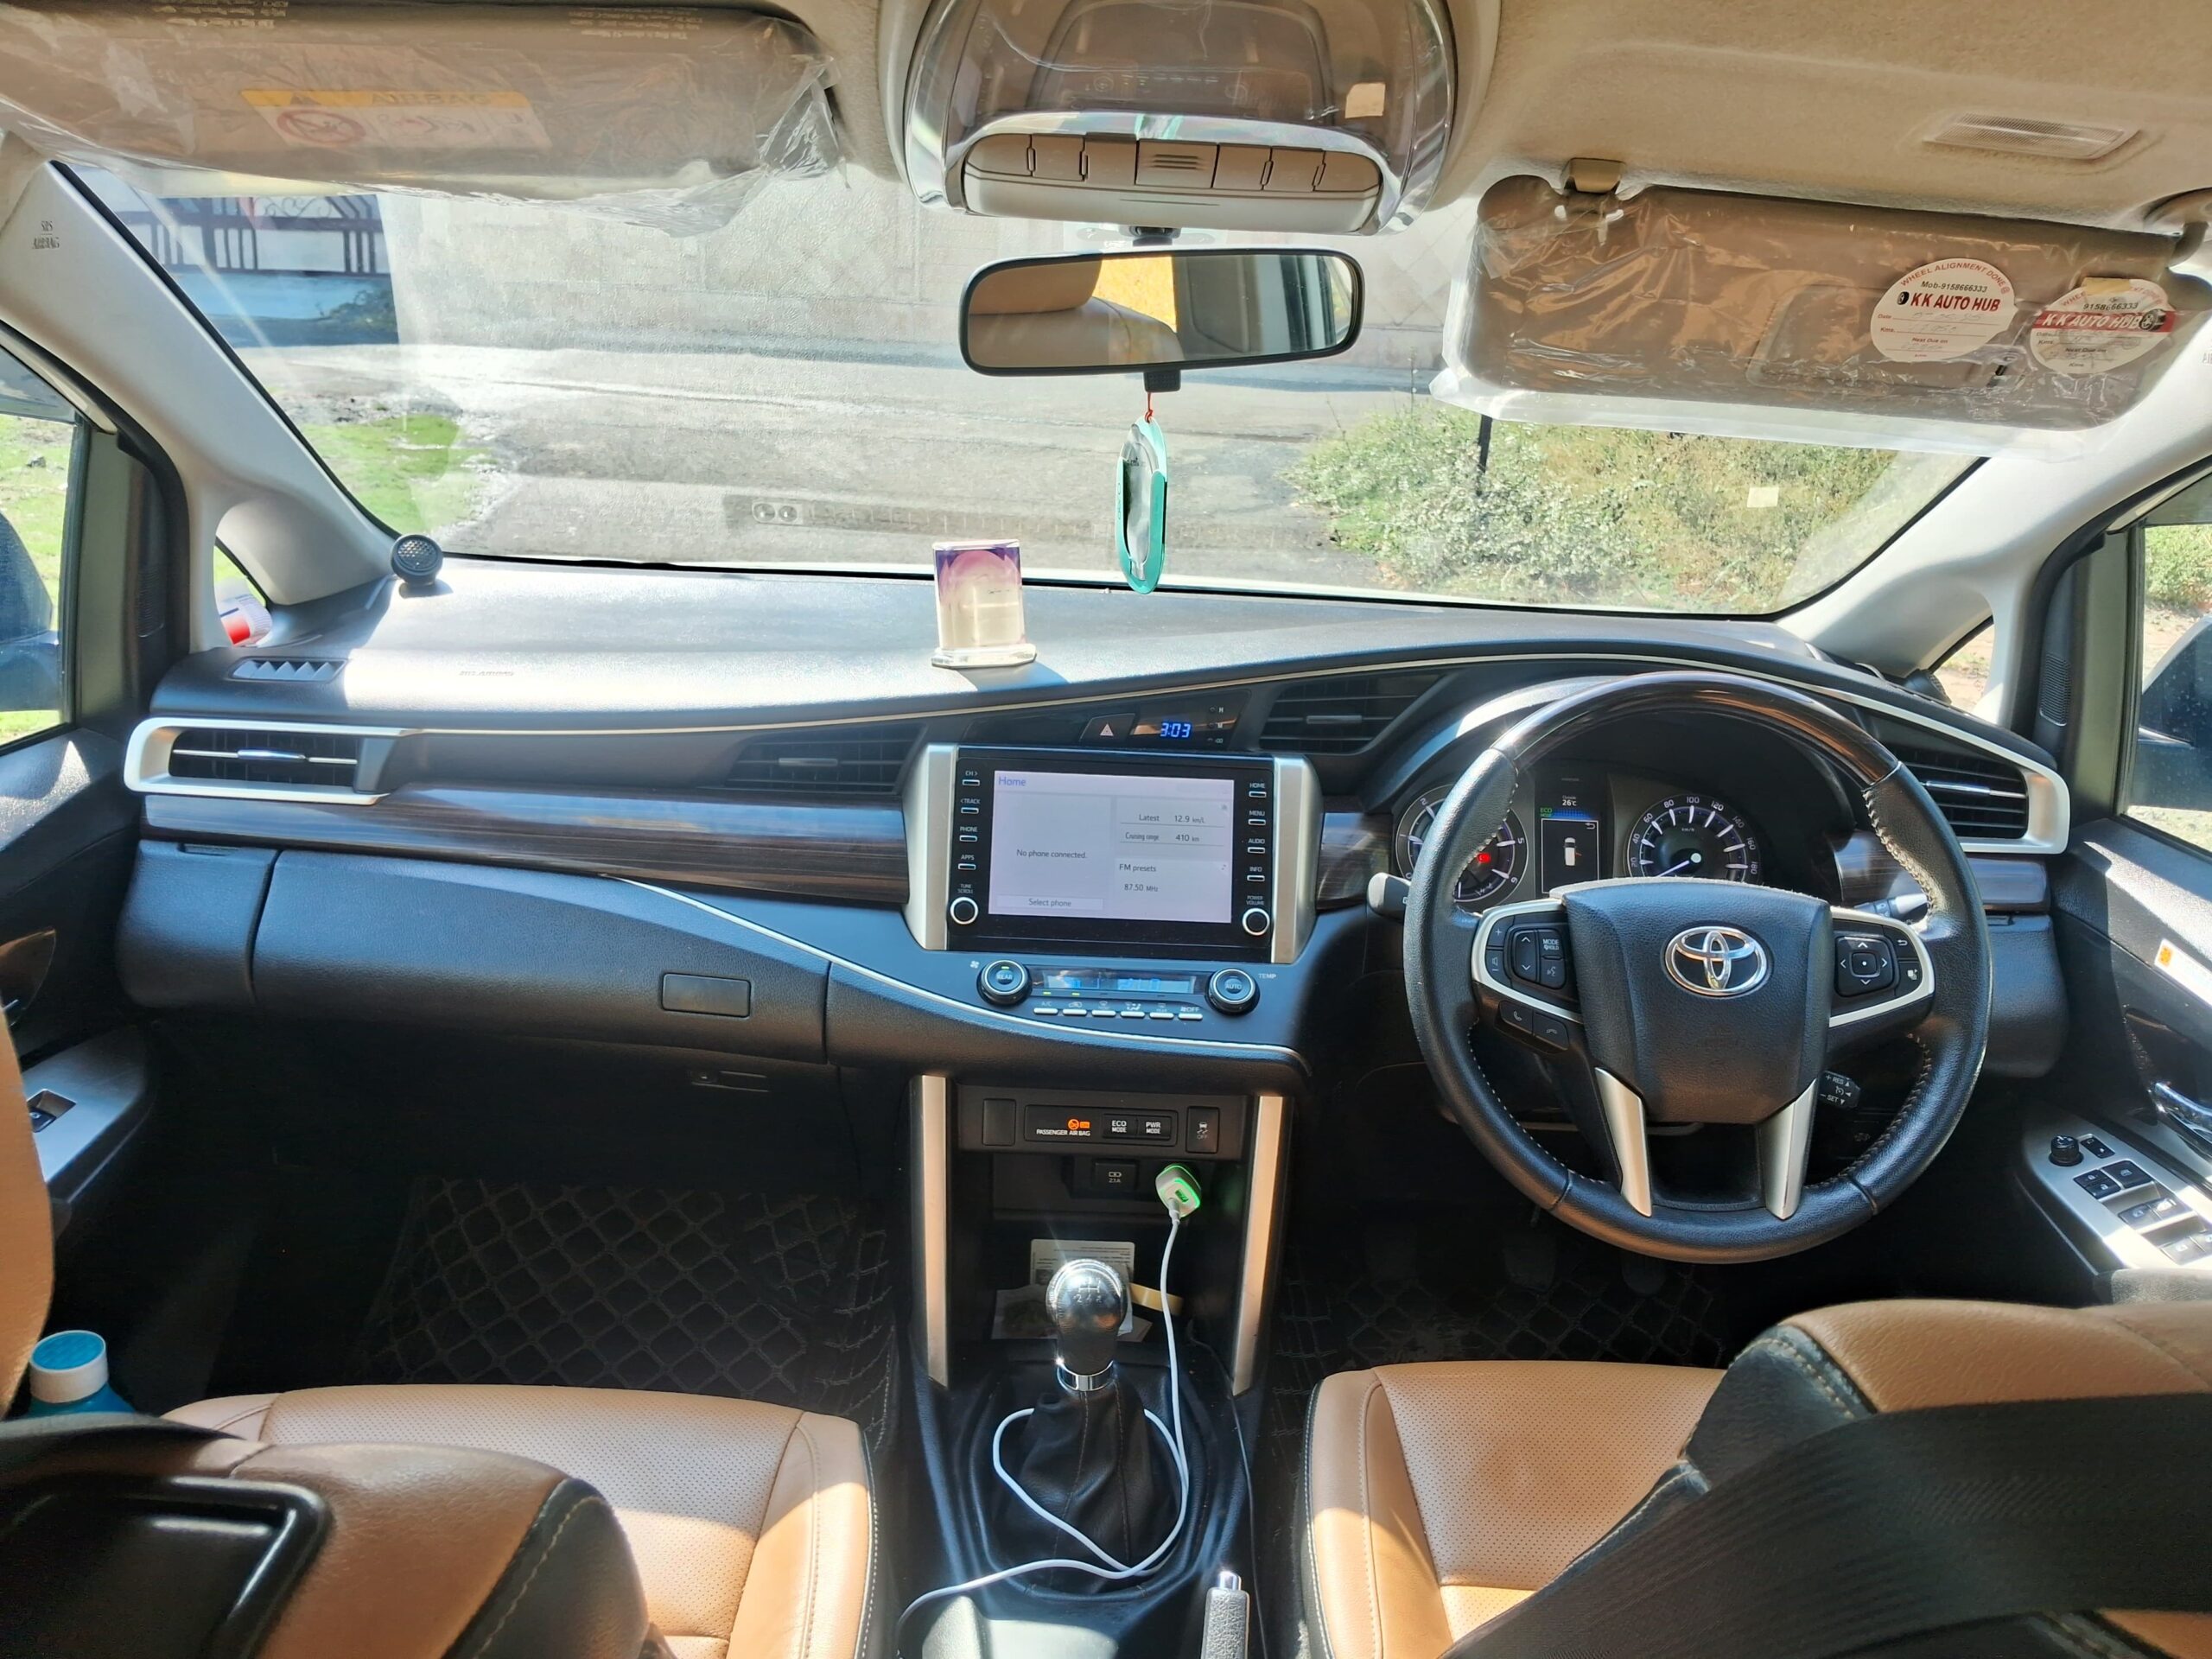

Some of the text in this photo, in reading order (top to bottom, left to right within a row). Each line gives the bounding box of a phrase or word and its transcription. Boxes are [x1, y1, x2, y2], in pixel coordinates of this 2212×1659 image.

[1901, 262, 2007, 288] WHEEL ALIGNMENT DONE
[1921, 281, 1988, 293] Mob-9158666333
[1934, 295, 1969, 310] AUTO
[1971, 297, 2001, 312] HUB
[2070, 315, 2107, 327] AUTO
[1160, 722, 1192, 738] 3:03
[998, 777, 1027, 786] Home
[1663, 799, 1675, 809] 80
[1711, 800, 1725, 811] 120
[1643, 812, 1654, 823] 60
[1732, 816, 1745, 829] 140
[1632, 833, 1641, 844] 40
[1747, 837, 1756, 850] 160
[1028, 898, 1049, 906] Select
[1827, 1094, 1839, 1103] SET
